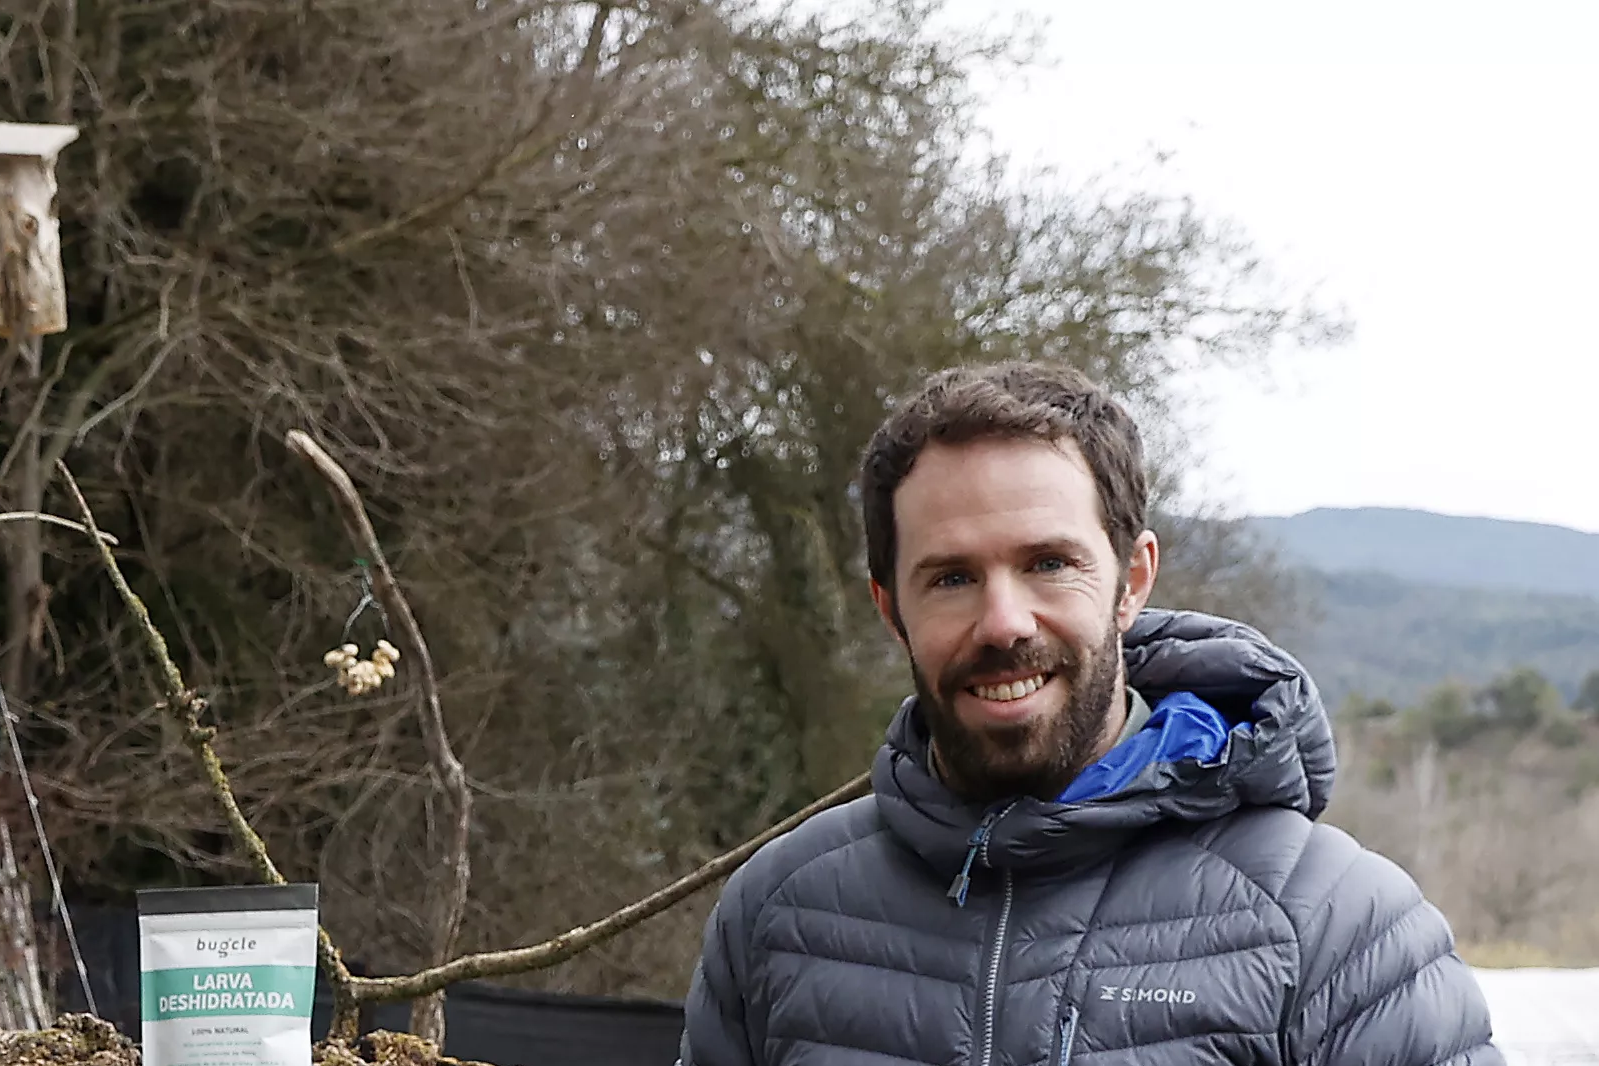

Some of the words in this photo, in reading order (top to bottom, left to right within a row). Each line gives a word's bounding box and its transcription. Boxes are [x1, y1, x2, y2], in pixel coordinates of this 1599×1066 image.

[197, 938, 257, 958] bugcle
[193, 973, 253, 991] LARVA
[159, 992, 295, 1013] DESHIDRATADA
[1121, 988, 1196, 1003] SIMOND
